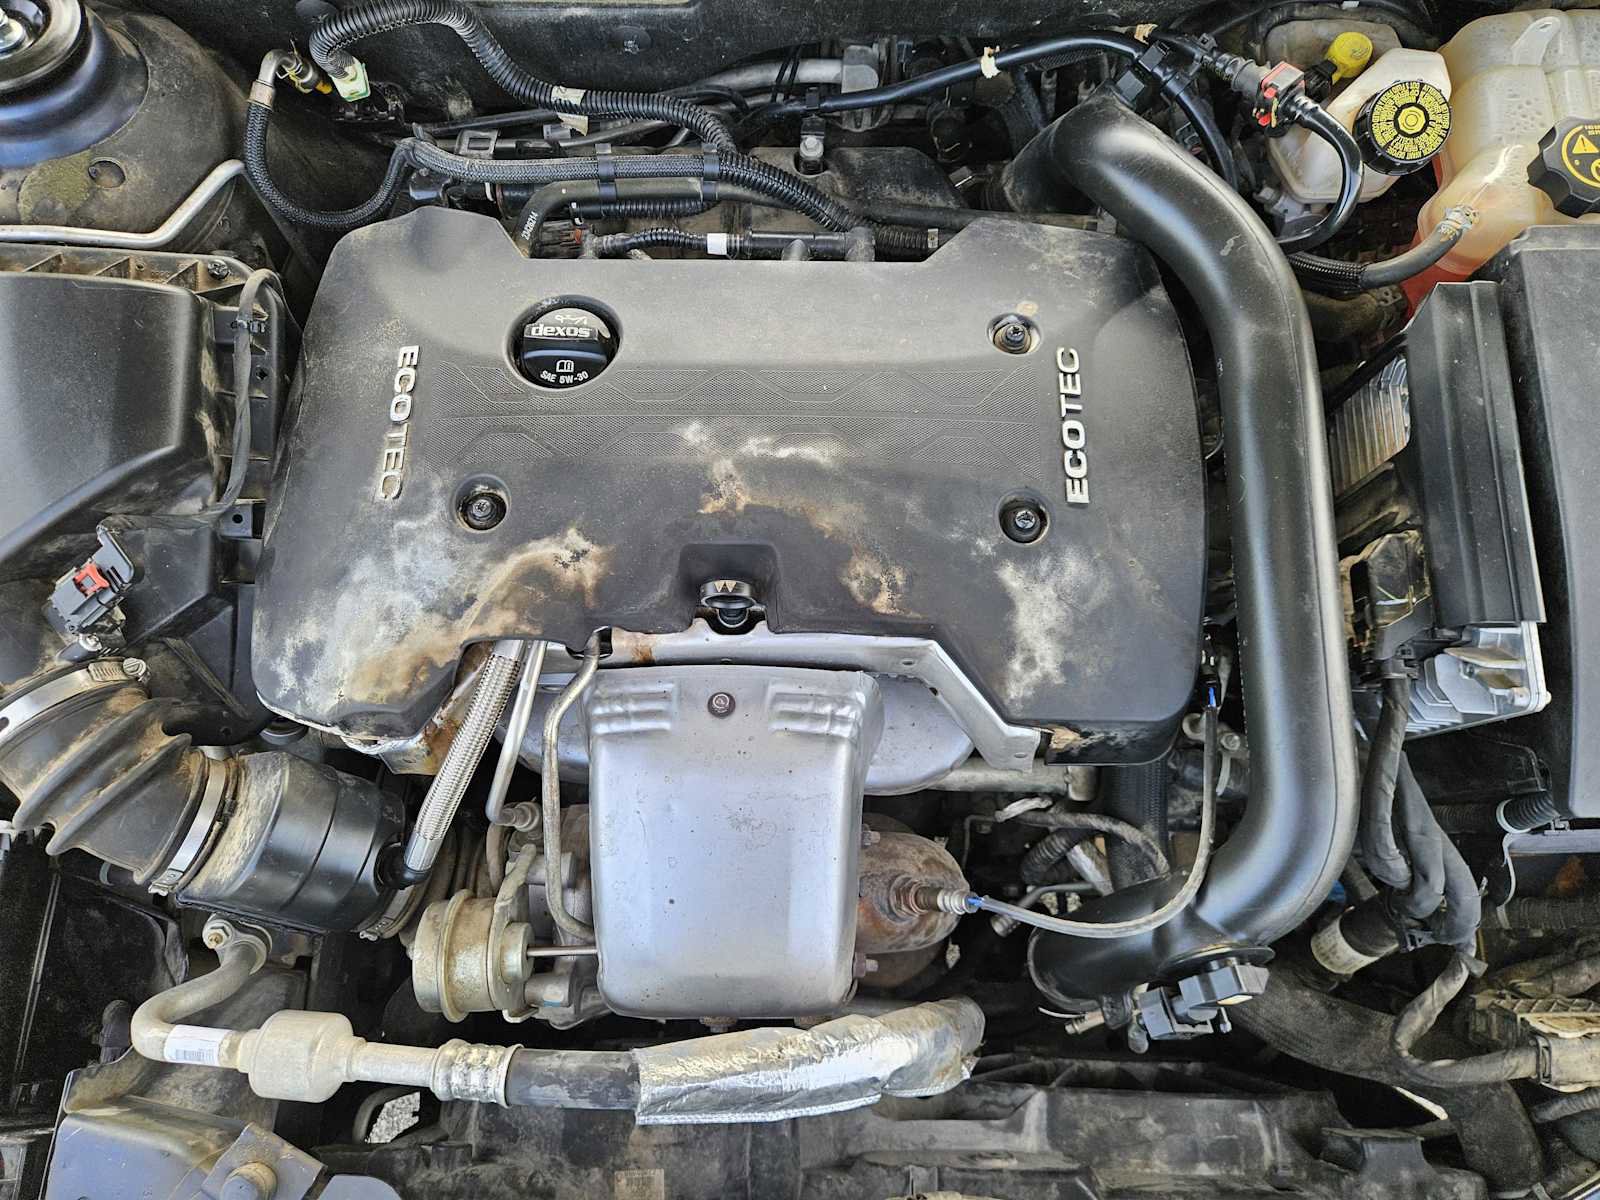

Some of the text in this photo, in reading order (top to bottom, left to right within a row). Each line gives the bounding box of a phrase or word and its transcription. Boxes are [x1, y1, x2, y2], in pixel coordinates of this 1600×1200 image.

[530, 323, 592, 338] dexos
[540, 370, 589, 384] SAE 5W-30
[380, 345, 420, 499] ECOTEC
[1056, 347, 1090, 504] ECOTEC
